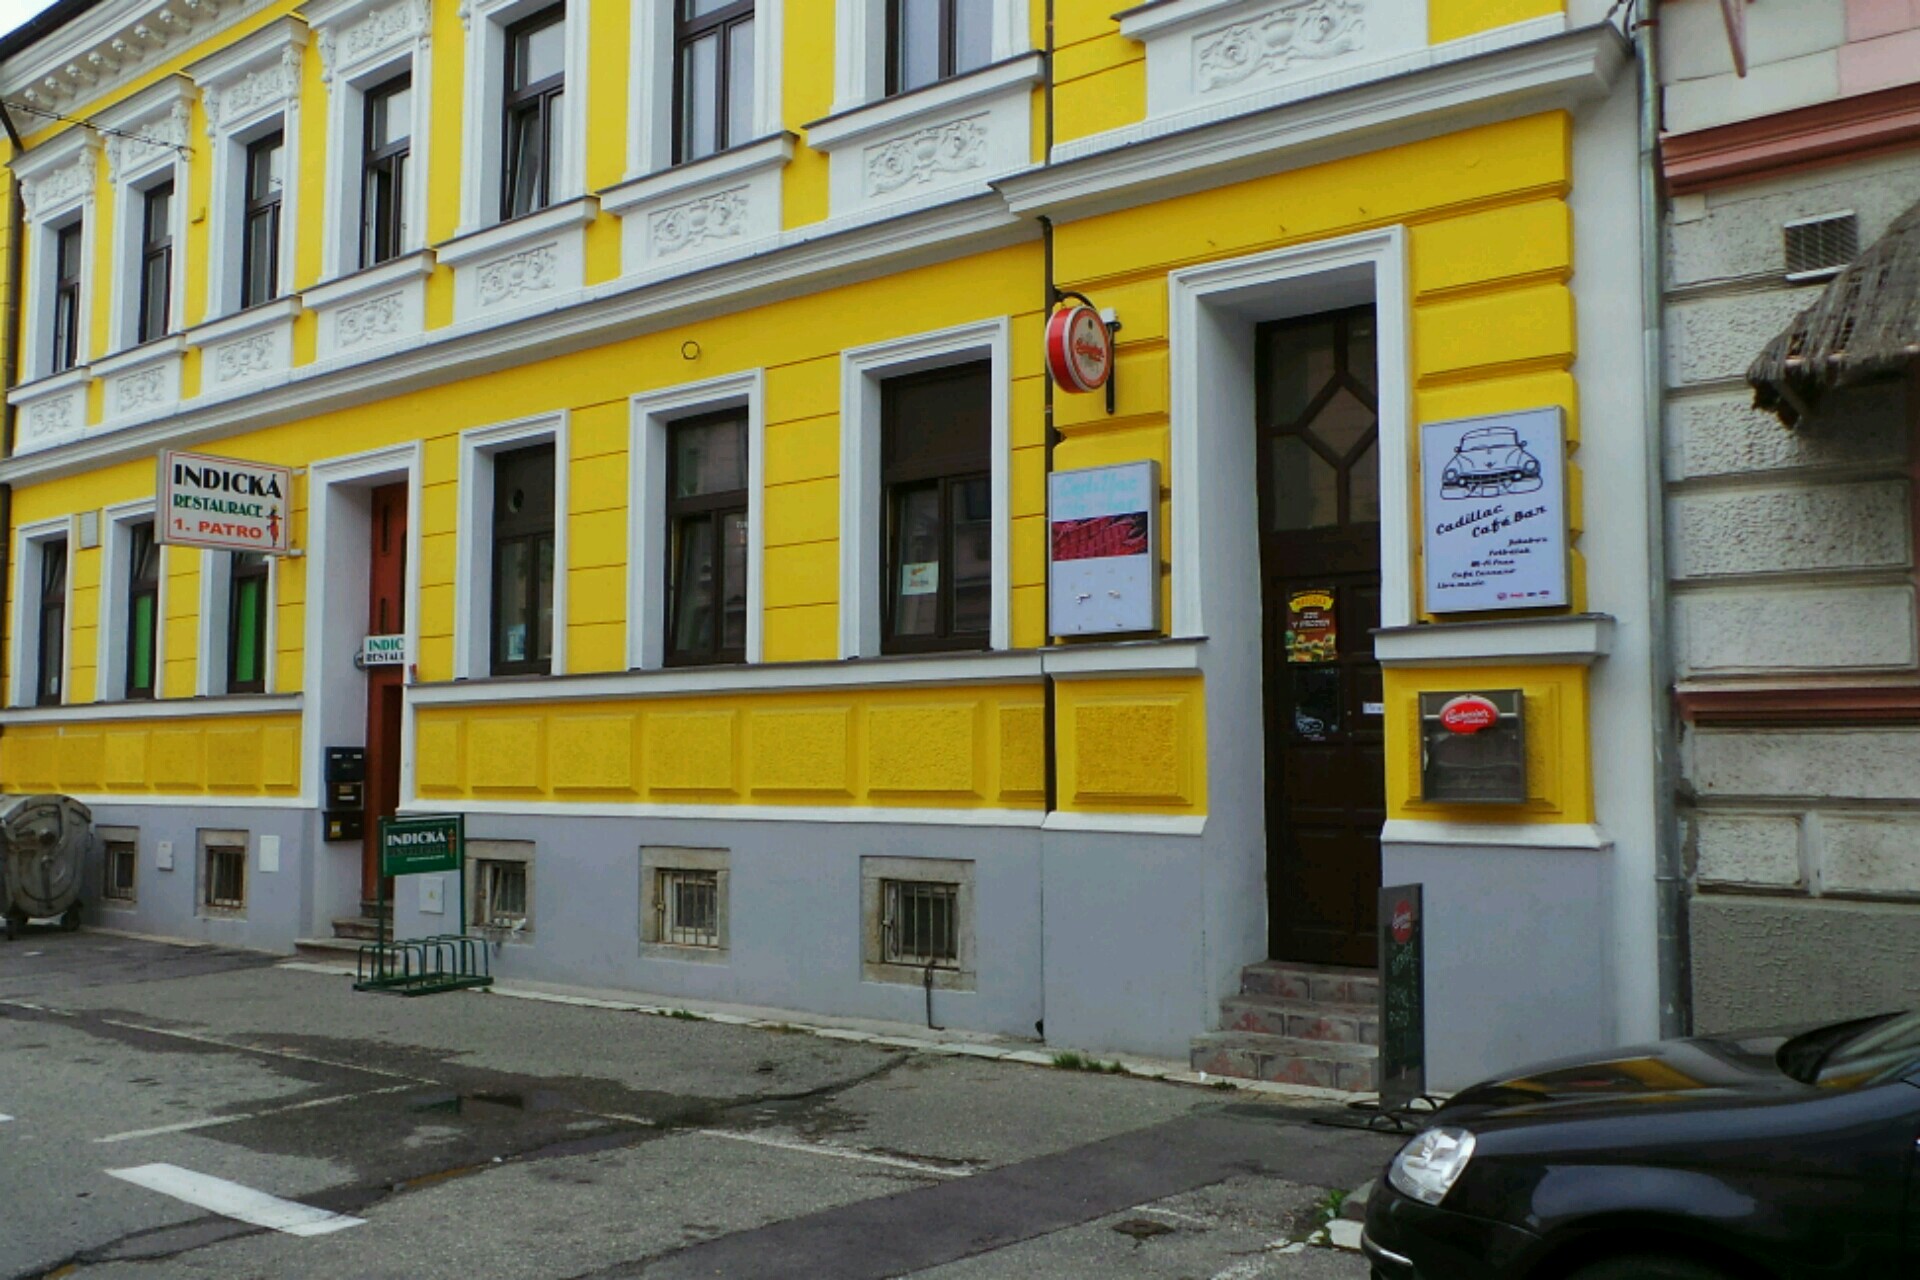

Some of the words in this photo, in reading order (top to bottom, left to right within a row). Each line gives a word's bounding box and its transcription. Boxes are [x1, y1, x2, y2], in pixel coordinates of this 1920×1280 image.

[174, 463, 282, 499] INDICKÁ
[173, 493, 263, 518] RESTAURACE
[174, 518, 191, 532] 1.
[198, 521, 263, 539] PATRO
[1436, 505, 1504, 535] Cadillac
[1471, 516, 1511, 537] Café
[1514, 506, 1547, 522] Bar
[387, 827, 447, 846] INDICKÁ
